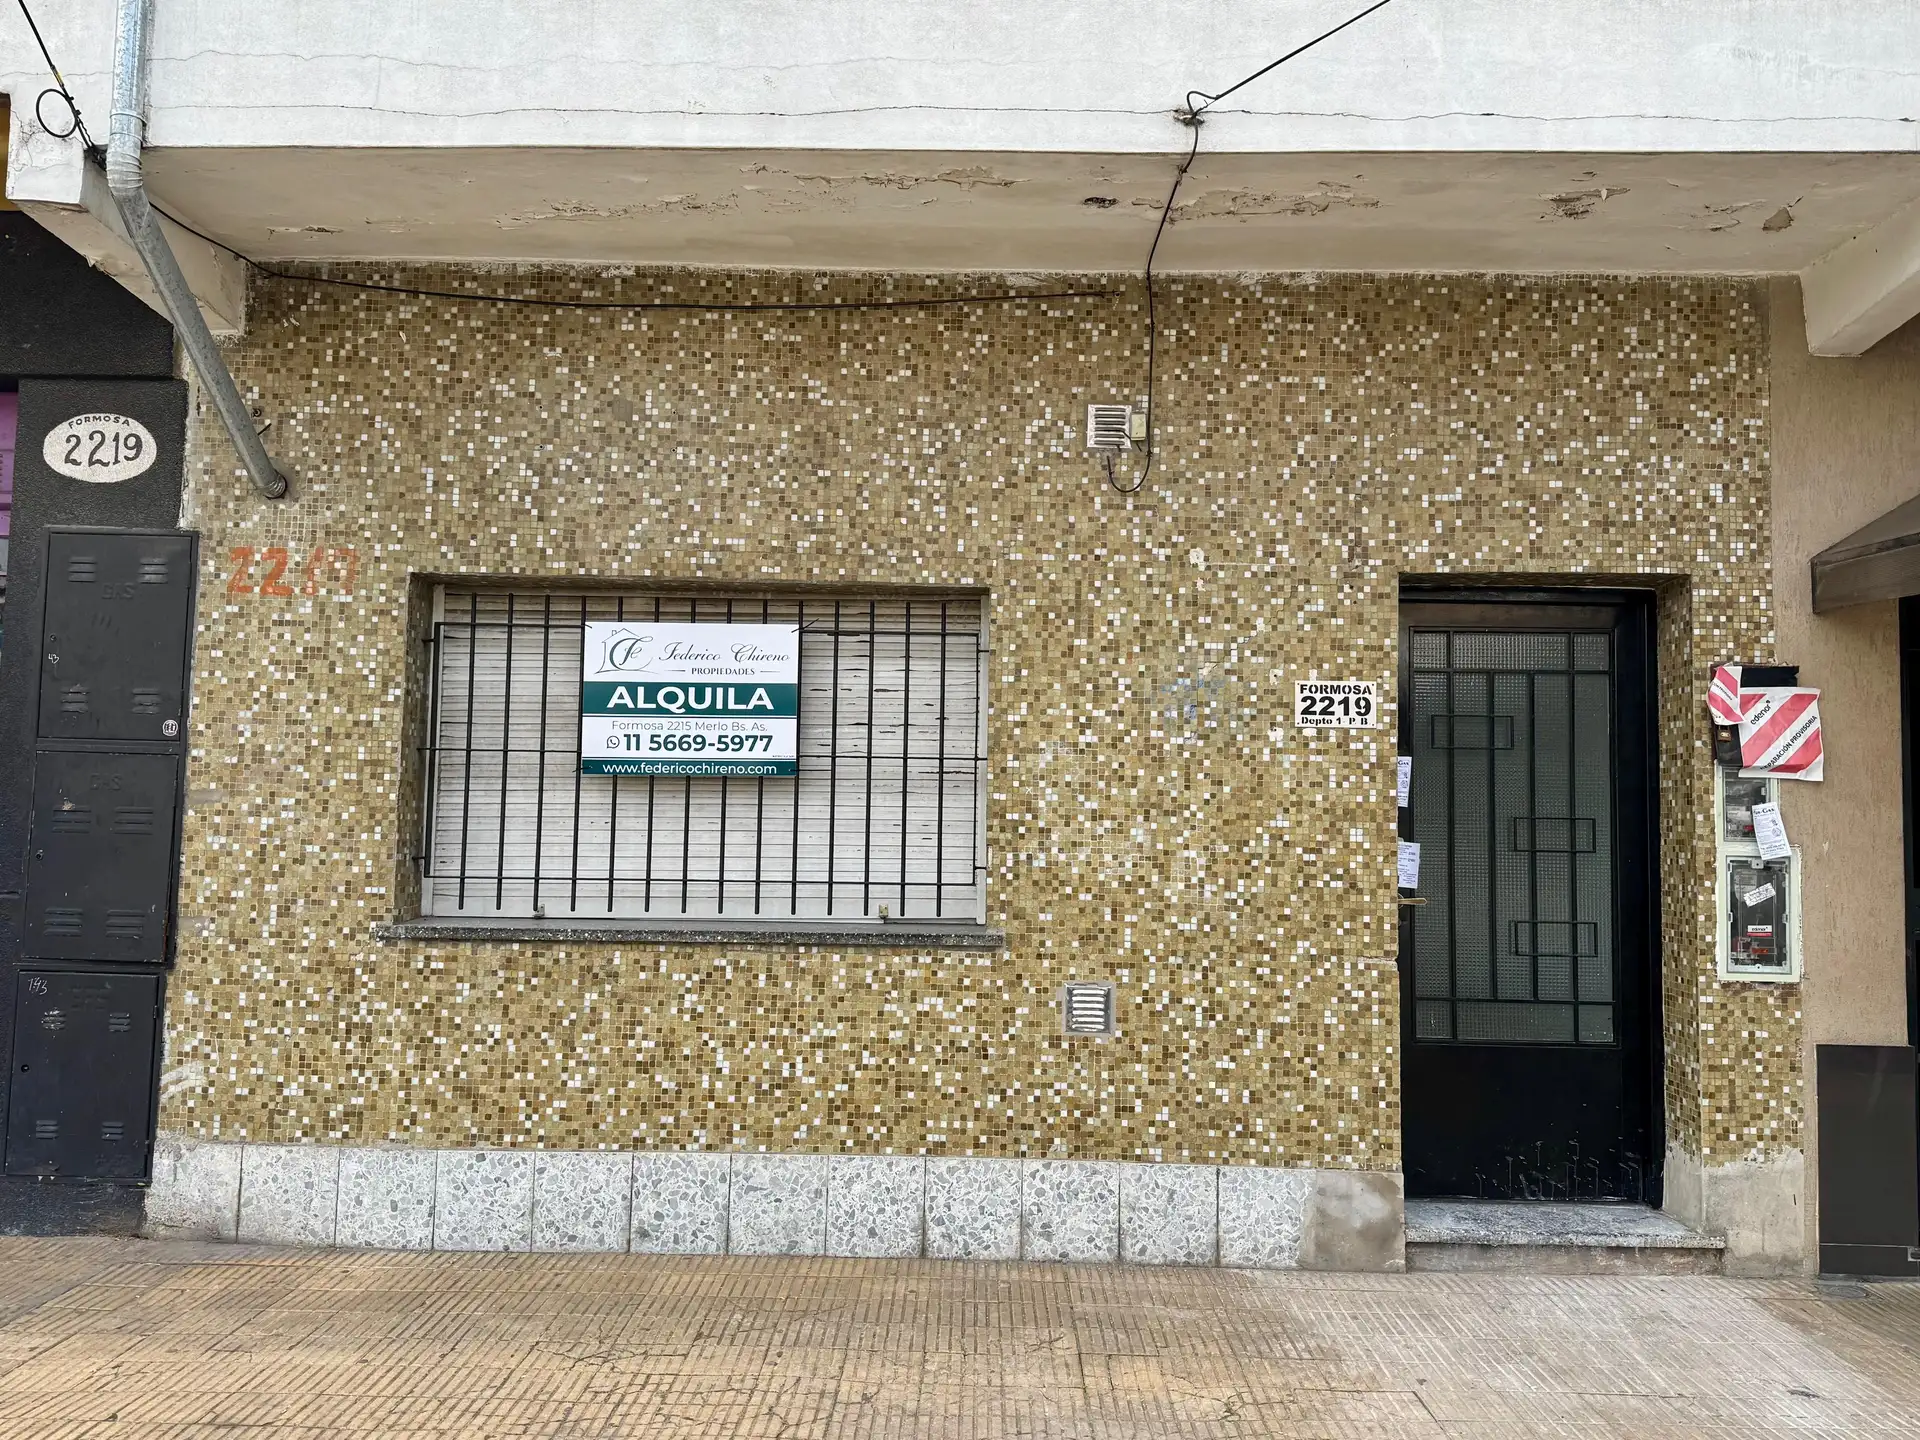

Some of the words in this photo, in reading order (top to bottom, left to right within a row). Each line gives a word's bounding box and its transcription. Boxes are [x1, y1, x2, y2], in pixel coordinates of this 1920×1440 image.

[67, 413, 131, 430] FORMOSA
[64, 429, 144, 468] 2219
[658, 641, 722, 662] Federico
[730, 643, 790, 663] Chireno
[691, 667, 756, 676] PROPIEDADES
[1299, 683, 1373, 695] FORMOSA
[606, 685, 775, 714] ALQUILA
[1300, 695, 1372, 717] 2219
[1301, 716, 1333, 726] Depto
[1750, 703, 1771, 725] edenor
[612, 720, 664, 731] Formosa
[667, 721, 691, 731] 2215
[695, 721, 729, 732] Merlo
[732, 721, 748, 732] Bs.
[751, 721, 768, 732] As.
[1790, 715, 1818, 744] PROVISORIA
[623, 733, 641, 751] 11
[648, 734, 773, 753] 5669-5977
[602, 761, 777, 775] www.federicochireno.com
